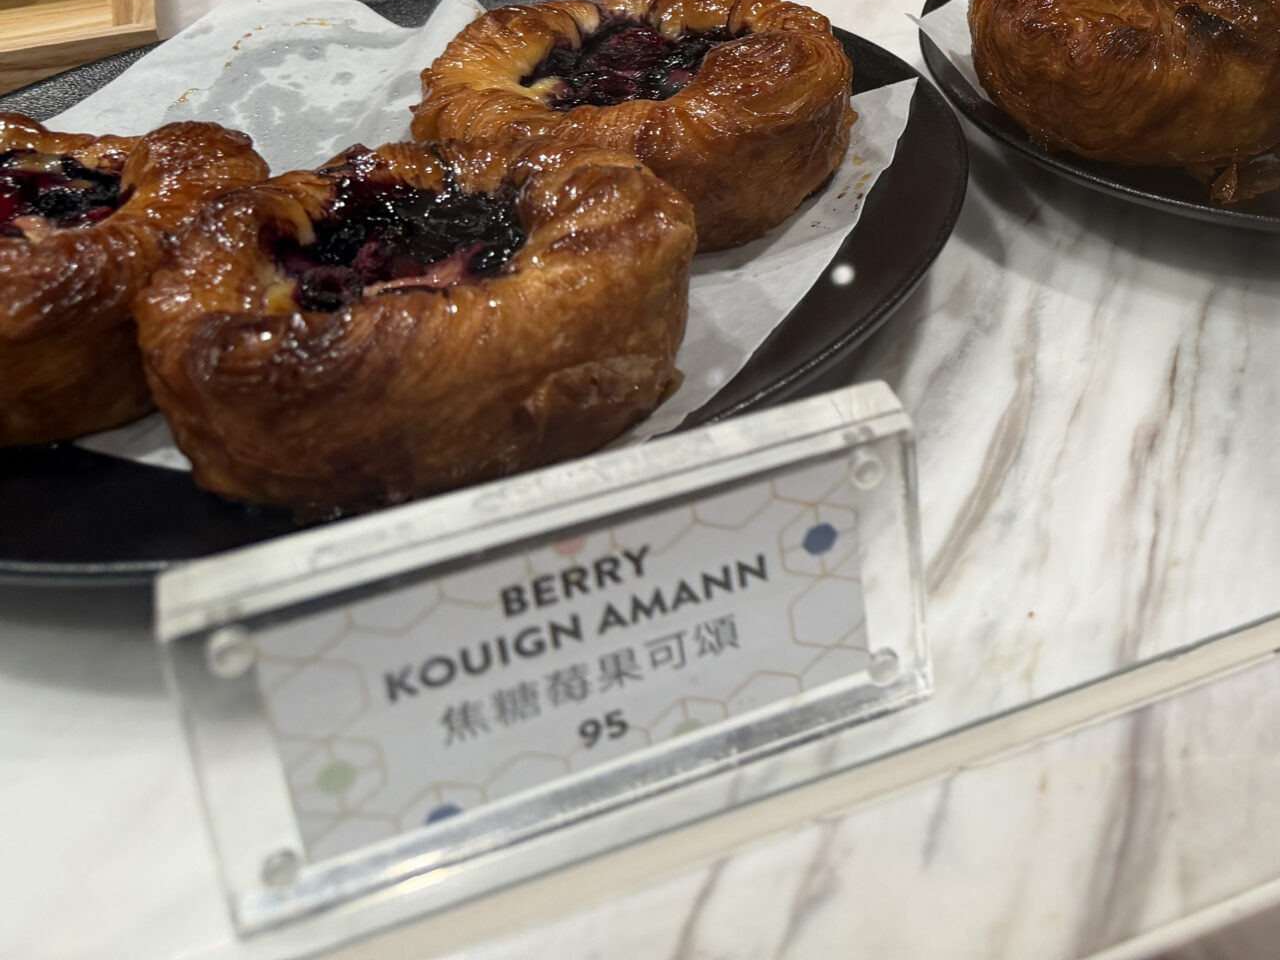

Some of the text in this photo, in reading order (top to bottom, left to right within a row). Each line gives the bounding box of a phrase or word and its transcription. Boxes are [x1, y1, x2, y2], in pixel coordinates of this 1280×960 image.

[381, 552, 769, 706] KOUIGN AMANN
[499, 543, 652, 619] BERRY
[437, 613, 742, 748] 焦糖莓果可頌
[577, 707, 631, 749] 95
